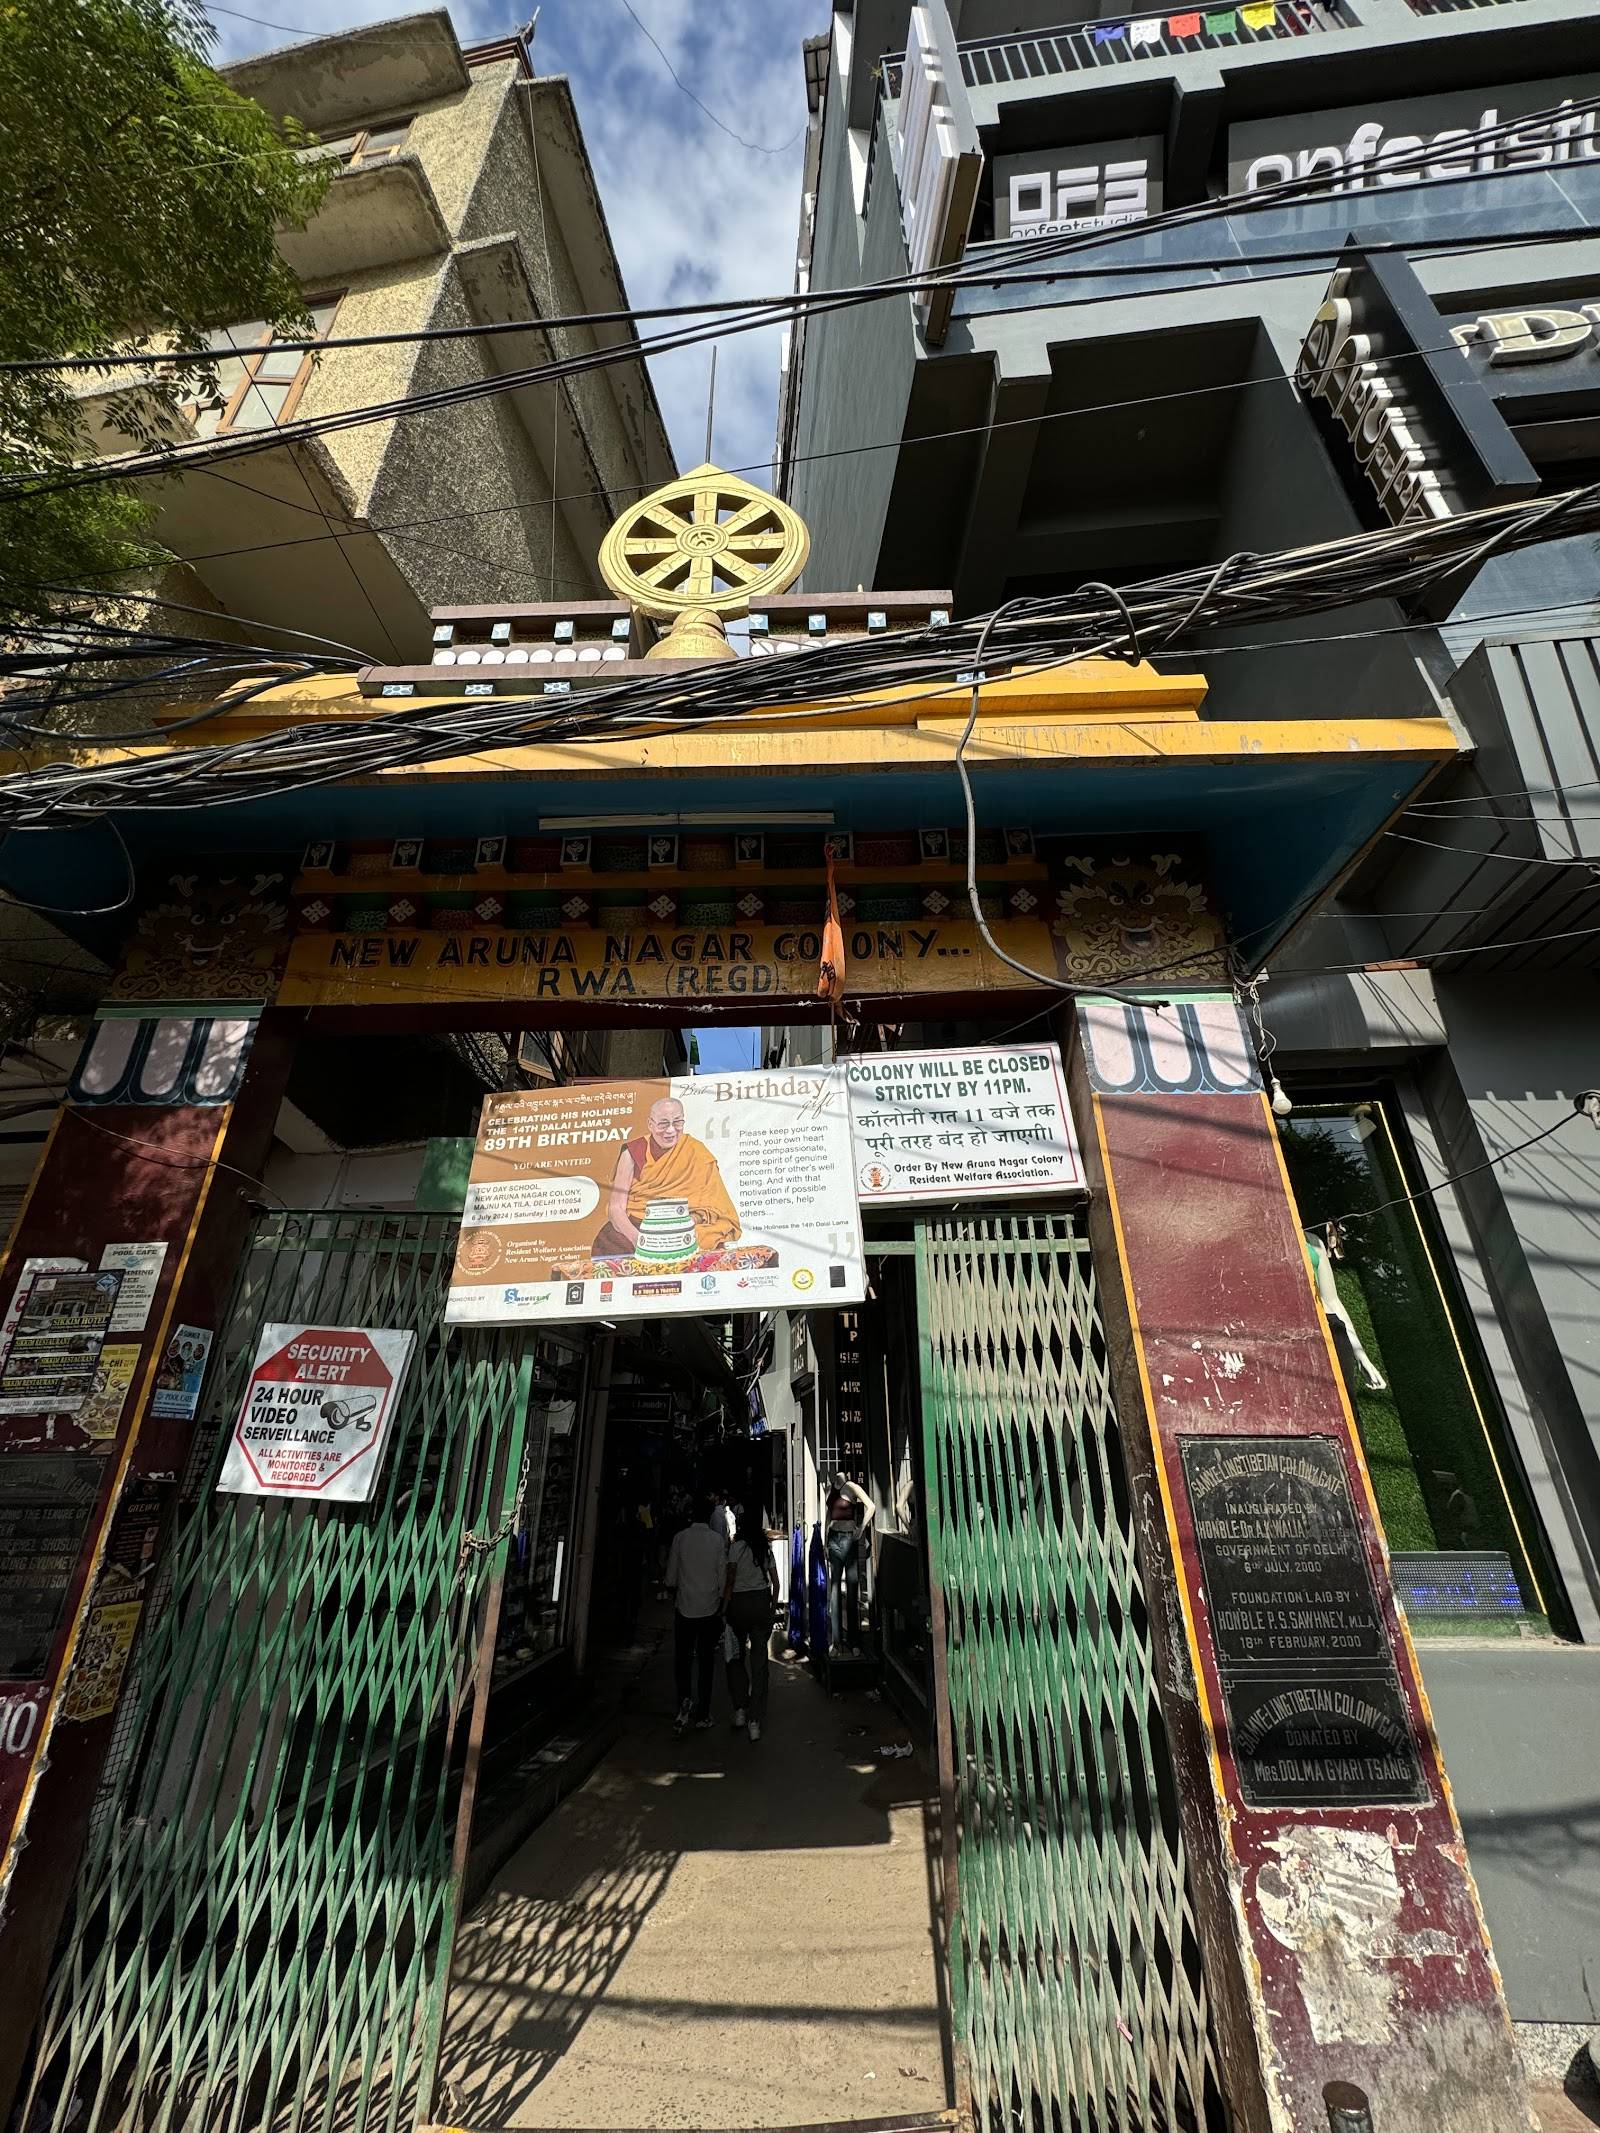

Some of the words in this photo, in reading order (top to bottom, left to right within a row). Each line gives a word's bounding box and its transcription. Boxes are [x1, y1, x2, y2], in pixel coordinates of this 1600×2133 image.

[329, 937, 420, 967] NEW
[437, 935, 577, 967] ARUNA
[603, 932, 754, 965] NAGAR
[773, 928, 973, 961] COONY...
[850, 1063, 914, 1082] COLONY
[920, 1062, 958, 1077] WILL
[963, 1060, 983, 1075] BE
[988, 1055, 1050, 1073] CLOSED
[714, 1075, 827, 1102] Birthday
[875, 1082, 951, 1101] STRICTLY
[958, 1081, 978, 1096] BY
[984, 1078, 1031, 1095] 11PM.
[488, 1113, 558, 1126] CELEBRATING
[561, 1112, 578, 1120] HIS
[582, 1107, 633, 1117] HOLINESS
[856, 1108, 925, 1128] कॉलोनी
[930, 1110, 958, 1124] रात
[965, 1108, 983, 1122] 11
[989, 1102, 1019, 1119] बजे
[1024, 1103, 1056, 1119] तक
[487, 1128, 507, 1136] THE
[512, 1125, 538, 1133] 14TH
[541, 1122, 572, 1131] DALAI
[739, 1129, 767, 1137] Please
[769, 1128, 789, 1137] keep
[791, 1126, 810, 1135] your
[484, 1136, 532, 1151] 89TH
[537, 1127, 633, 1147] BIRTHDAY
[764, 1138, 782, 1148] your
[803, 1134, 824, 1142] heart
[864, 1134, 894, 1158] पूरी
[899, 1134, 933, 1150] तरह
[936, 1131, 964, 1148] बंद
[968, 1127, 988, 1147] हो
[513, 1161, 533, 1170] YOU
[535, 1160, 553, 1169] ARE
[554, 1158, 592, 1167] INVITED
[762, 1157, 782, 1165] spirit
[795, 1154, 827, 1164] genuine
[894, 1164, 921, 1173] Order
[926, 1162, 937, 1172] By
[941, 1160, 963, 1170] New
[966, 1159, 996, 1169] Aruna
[999, 1157, 1028, 1169] Nagar
[1031, 1154, 1063, 1167] Colony
[740, 1169, 772, 1177] concern
[775, 1166, 785, 1174] for
[767, 1177, 784, 1185] And
[909, 1173, 951, 1185] Resident
[954, 1172, 992, 1183] Welfare
[477, 1186, 491, 1194] TCV
[493, 1185, 507, 1193] DAY
[494, 1193, 520, 1201] ARUNA
[521, 1191, 548, 1199] NAGAR
[740, 1187, 782, 1196] motivation
[792, 1184, 826, 1194] possible
[474, 1203, 500, 1211] MAJNU
[533, 1199, 556, 1207] DELHI
[797, 1195, 814, 1204] help
[477, 1213, 492, 1221] July
[514, 1210, 544, 1219] Saturday
[506, 1248, 532, 1256] Resident
[52, 1318, 80, 1326] SIKKIM
[82, 1317, 107, 1325] HOTEL
[287, 1344, 371, 1363] SECURITY
[295, 1364, 350, 1381] ALERT
[254, 1386, 273, 1403] 24
[277, 1387, 325, 1405] HOUR
[251, 1407, 298, 1425] VIDEO
[244, 1426, 336, 1444] SERVEILLANCE
[258, 1448, 274, 1458] ALL
[275, 1449, 322, 1461] ACTIVITIES
[323, 1451, 341, 1462] ARE
[267, 1459, 317, 1471] MONITORED
[319, 1462, 325, 1472] &
[271, 1472, 316, 1482] RECORDED
[1241, 1453, 1279, 1473] TIBETAN
[1318, 1470, 1344, 1497] GATE
[1226, 1503, 1302, 1515] INAUGURATED
[1216, 1544, 1290, 1556] GOVERNMENT
[1295, 1544, 1310, 1554] OF
[1314, 1544, 1348, 1555] DELHI
[1296, 1562, 1322, 1572] 2000
[1232, 1592, 1302, 1604] FOUNDATION
[1305, 1591, 1333, 1603] LAID
[1335, 1591, 1350, 1602] BY
[1331, 1635, 1361, 1647] 2000
[1287, 1688, 1333, 1715] TIBETAN
[1334, 1692, 1382, 1729] COLONY
[1377, 1715, 1409, 1756] GATE
[1284, 1729, 1341, 1747] DONATED
[1343, 1728, 1360, 1745] BY
[1279, 1760, 1324, 1782] DOLMA
[1326, 1758, 1364, 1781] GYARI
